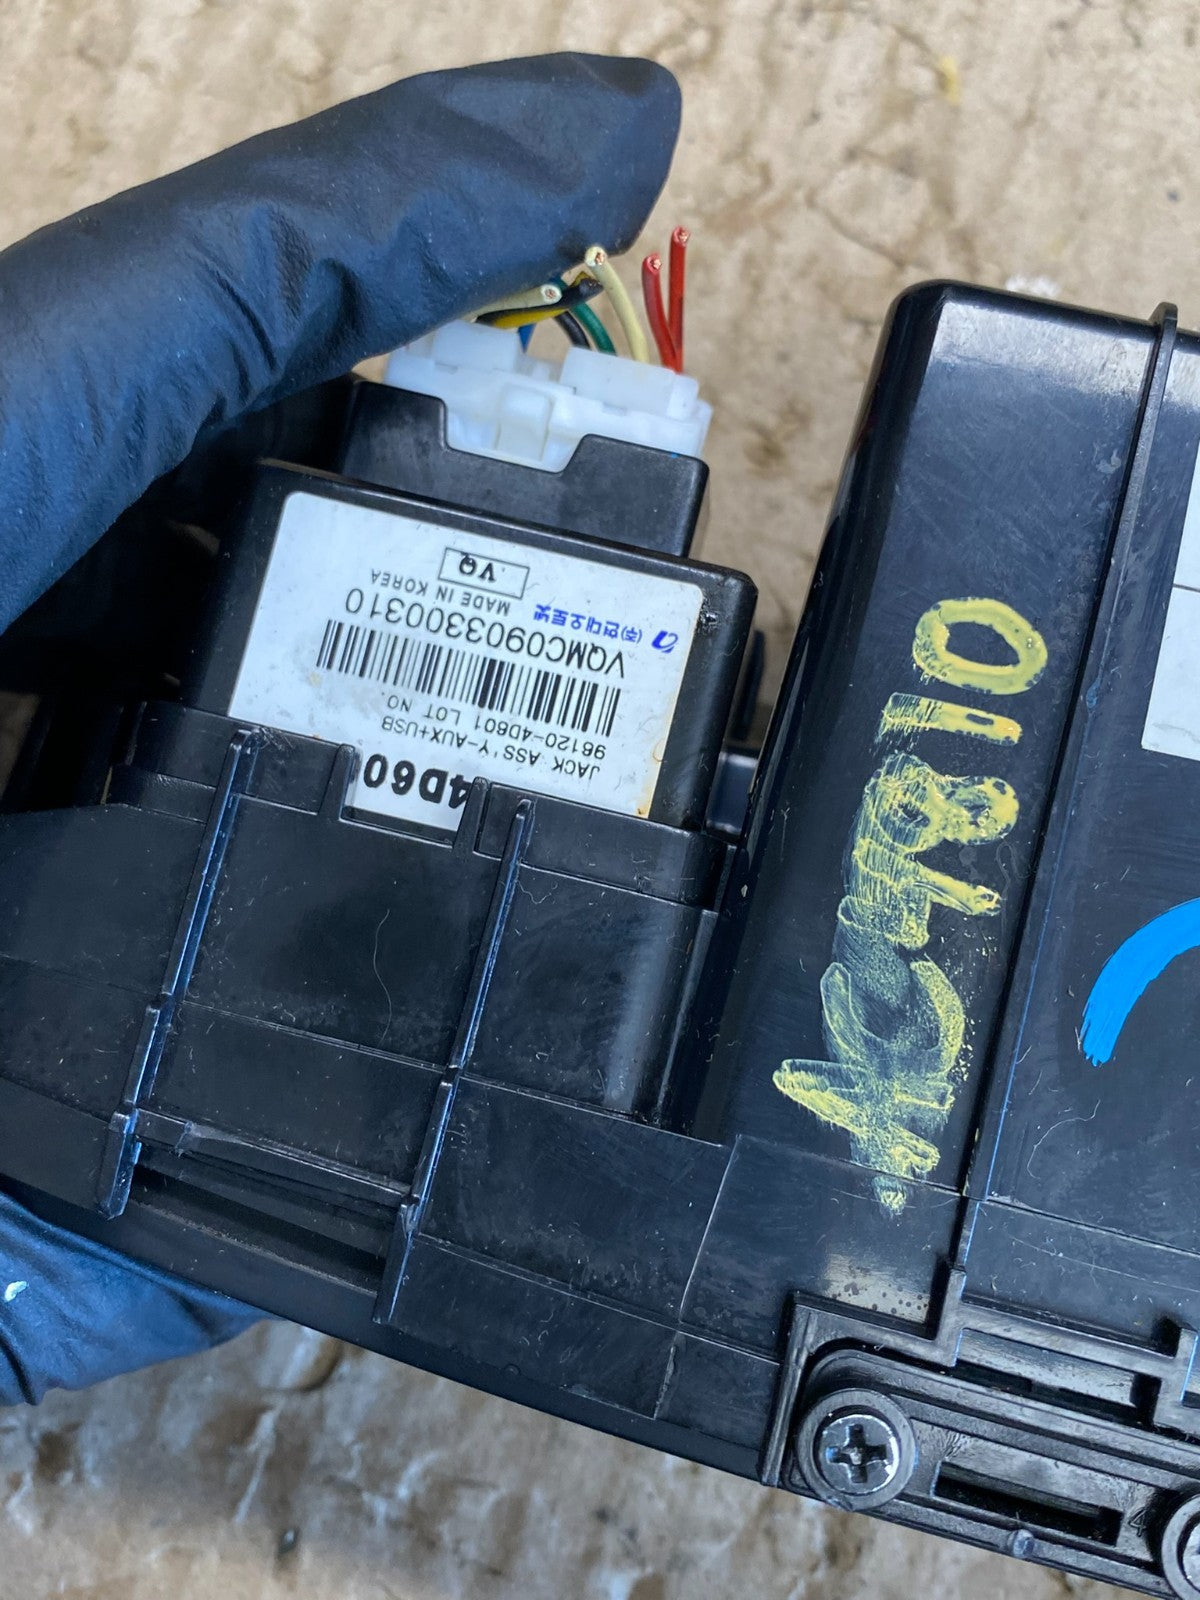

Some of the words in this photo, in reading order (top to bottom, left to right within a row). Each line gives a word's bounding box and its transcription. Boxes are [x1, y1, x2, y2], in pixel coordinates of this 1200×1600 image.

[458, 551, 496, 582] VQ
[371, 568, 429, 597] KOREA
[435, 585, 455, 603] IN
[461, 592, 511, 617] MADE
[345, 588, 625, 679] VQMC0903300310
[381, 691, 413, 712] NO.
[424, 704, 461, 725] LOT
[474, 716, 606, 760] 96120-4D601
[552, 755, 601, 780] JACK
